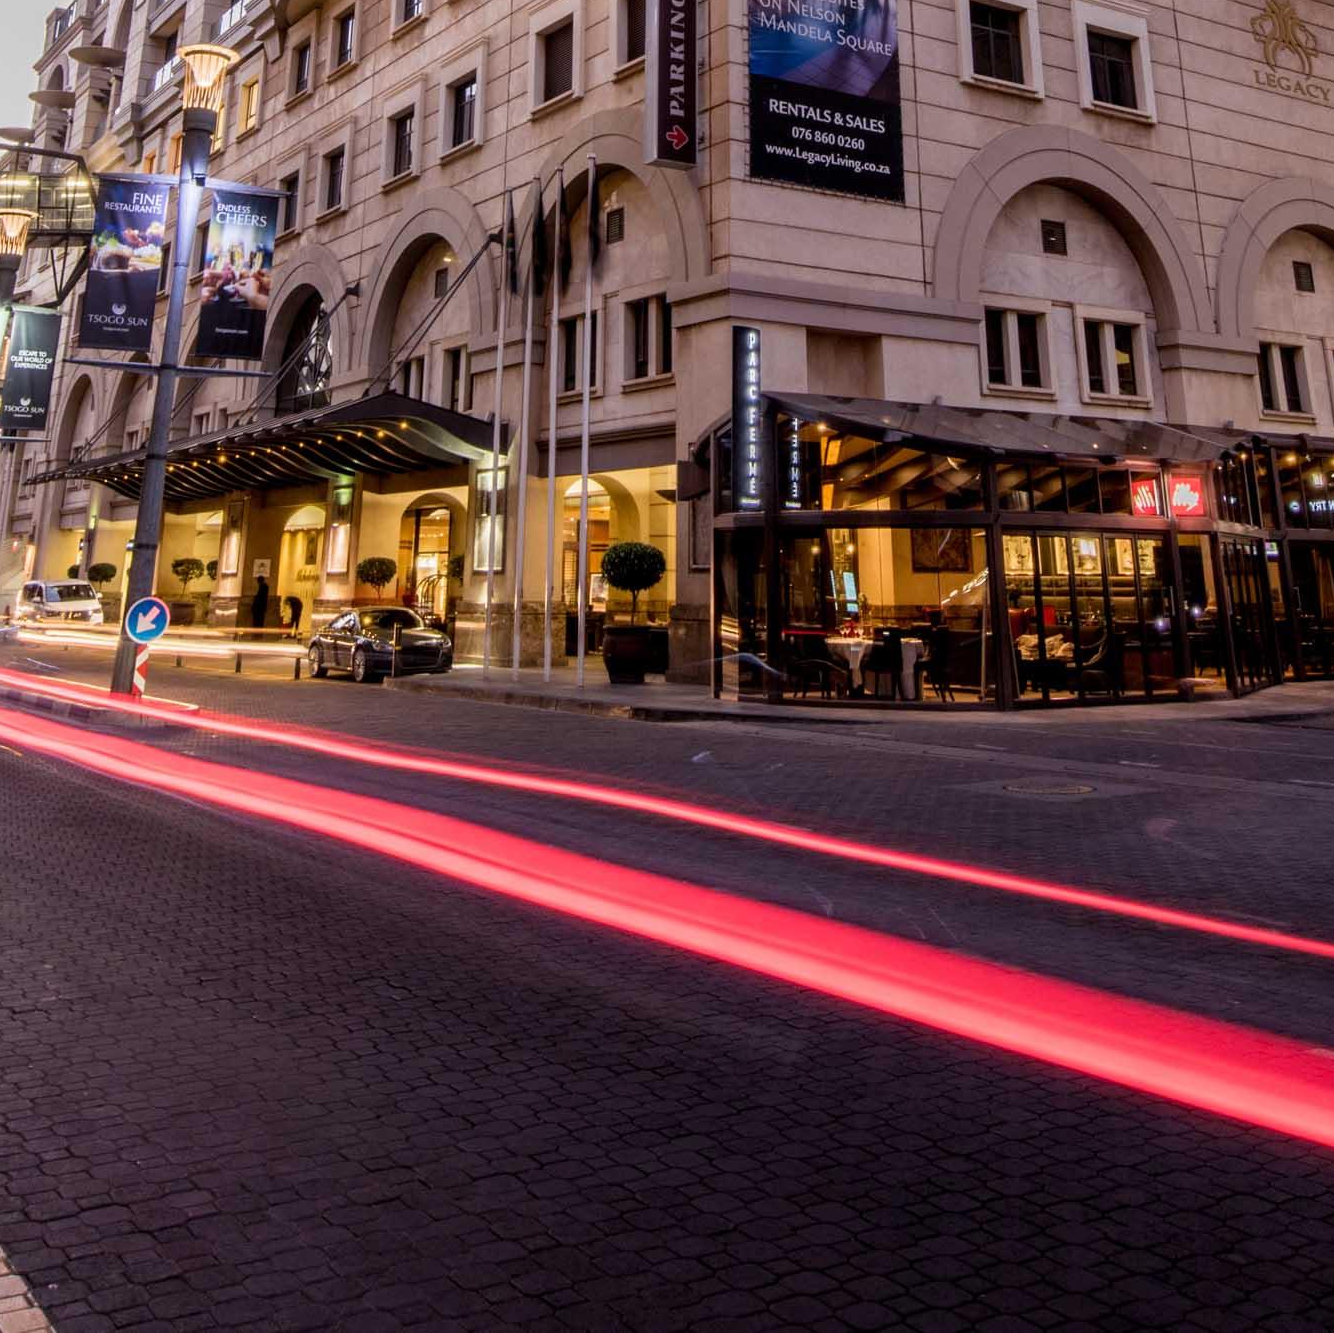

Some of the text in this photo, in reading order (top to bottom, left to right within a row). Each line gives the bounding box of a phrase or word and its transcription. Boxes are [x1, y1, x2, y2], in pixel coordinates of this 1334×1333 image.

[787, 0, 846, 26] NELSON
[760, 12, 892, 56] MANDELA SQUARE
[1253, 69, 1331, 101] LEGACY
[769, 98, 886, 134] RENTALS & SALES
[791, 126, 865, 150] 076 860 0260
[765, 144, 891, 175] www.LegacyLiving.co.za
[104, 201, 163, 215] RESTAURANTS
[132, 192, 164, 206] FINE
[217, 203, 251, 214] ENDLESS
[216, 212, 267, 227] CHEERS
[88, 313, 148, 326] TSOGO SUN
[747, 333, 757, 399] PARC
[4, 404, 45, 414] TSOGO SUN
